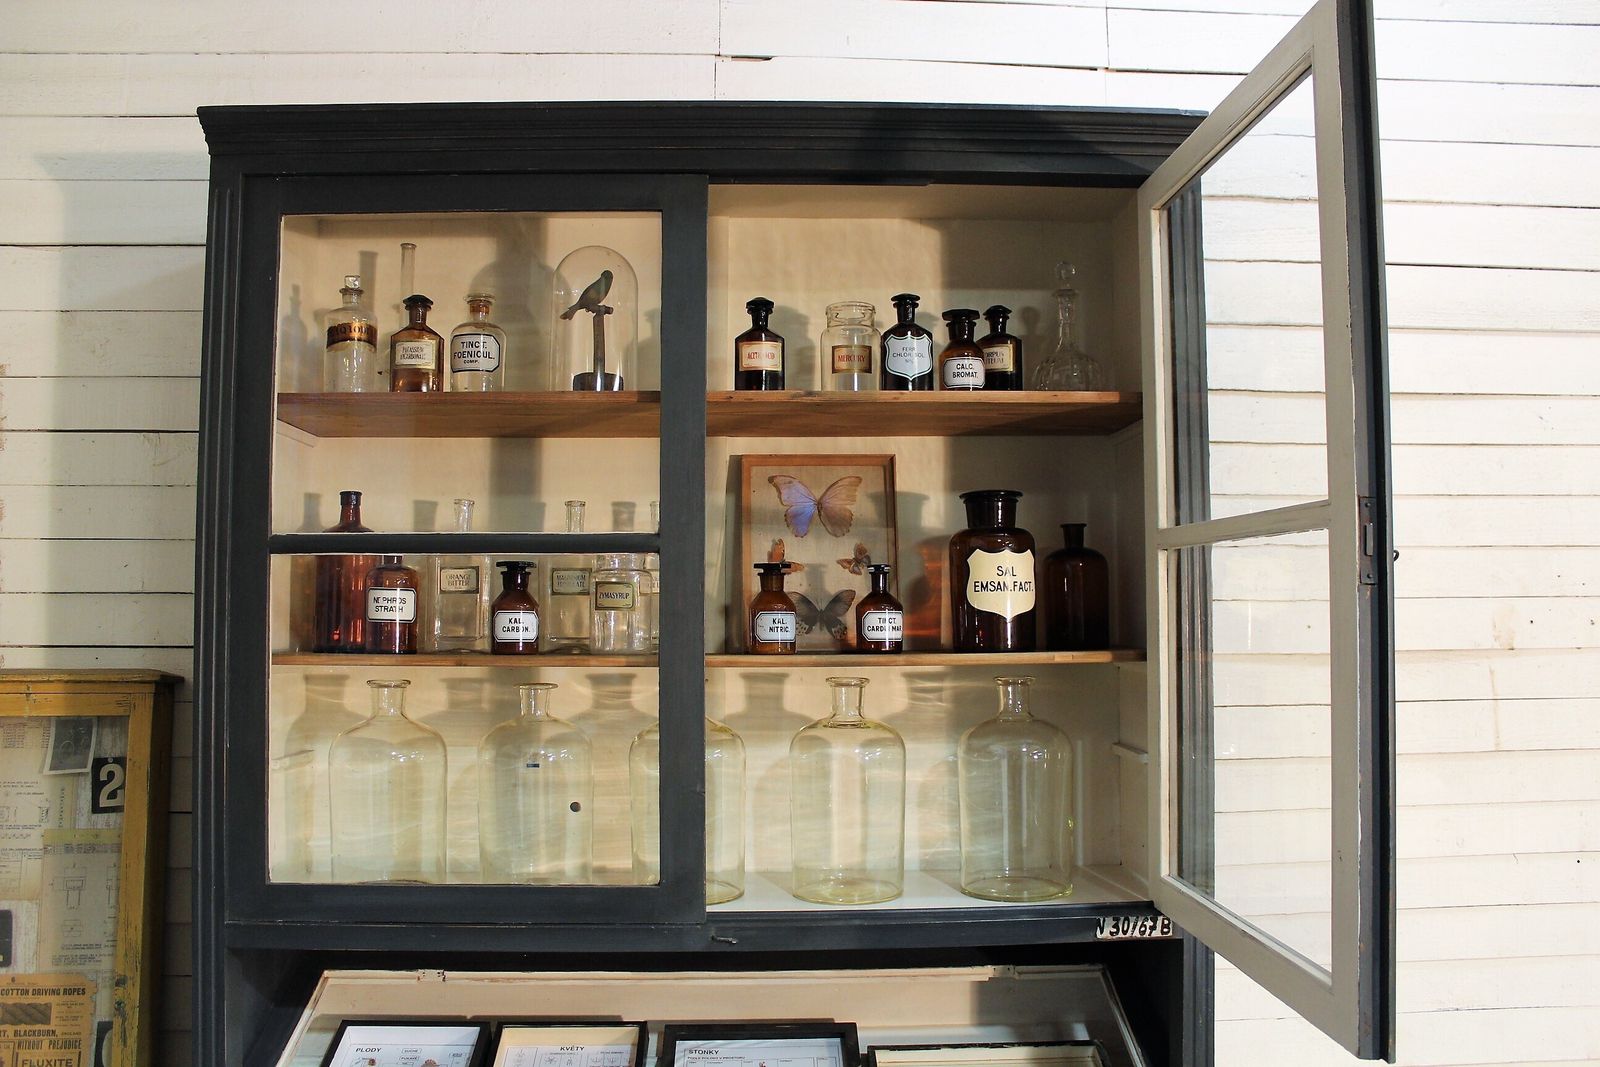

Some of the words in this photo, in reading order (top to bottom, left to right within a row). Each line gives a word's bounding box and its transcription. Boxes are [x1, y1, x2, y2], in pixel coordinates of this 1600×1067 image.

[460, 341, 486, 349] TINCT.
[453, 350, 495, 360] FOENICUL.
[837, 354, 865, 362] MERCURY
[956, 363, 974, 371] CALC.
[952, 371, 978, 379] BROMAT.
[996, 565, 1016, 576] SAL
[597, 591, 629, 600] ZYMASYRUP
[375, 605, 404, 613] STRATH
[507, 617, 523, 625] KAL.
[501, 625, 530, 633] CARBON.
[768, 625, 790, 633] NITRIC.
[99, 763, 125, 808] 2
[1, 987, 30, 997] COTTON
[31, 987, 61, 997] DRIVING
[62, 987, 86, 997] ROPES
[14, 1029, 58, 1038] BLACKBURN,
[17, 1040, 43, 1050] WITHOUT
[48, 1039, 82, 1050] PREJUDICE
[22, 1058, 73, 1067] FLUXITE
